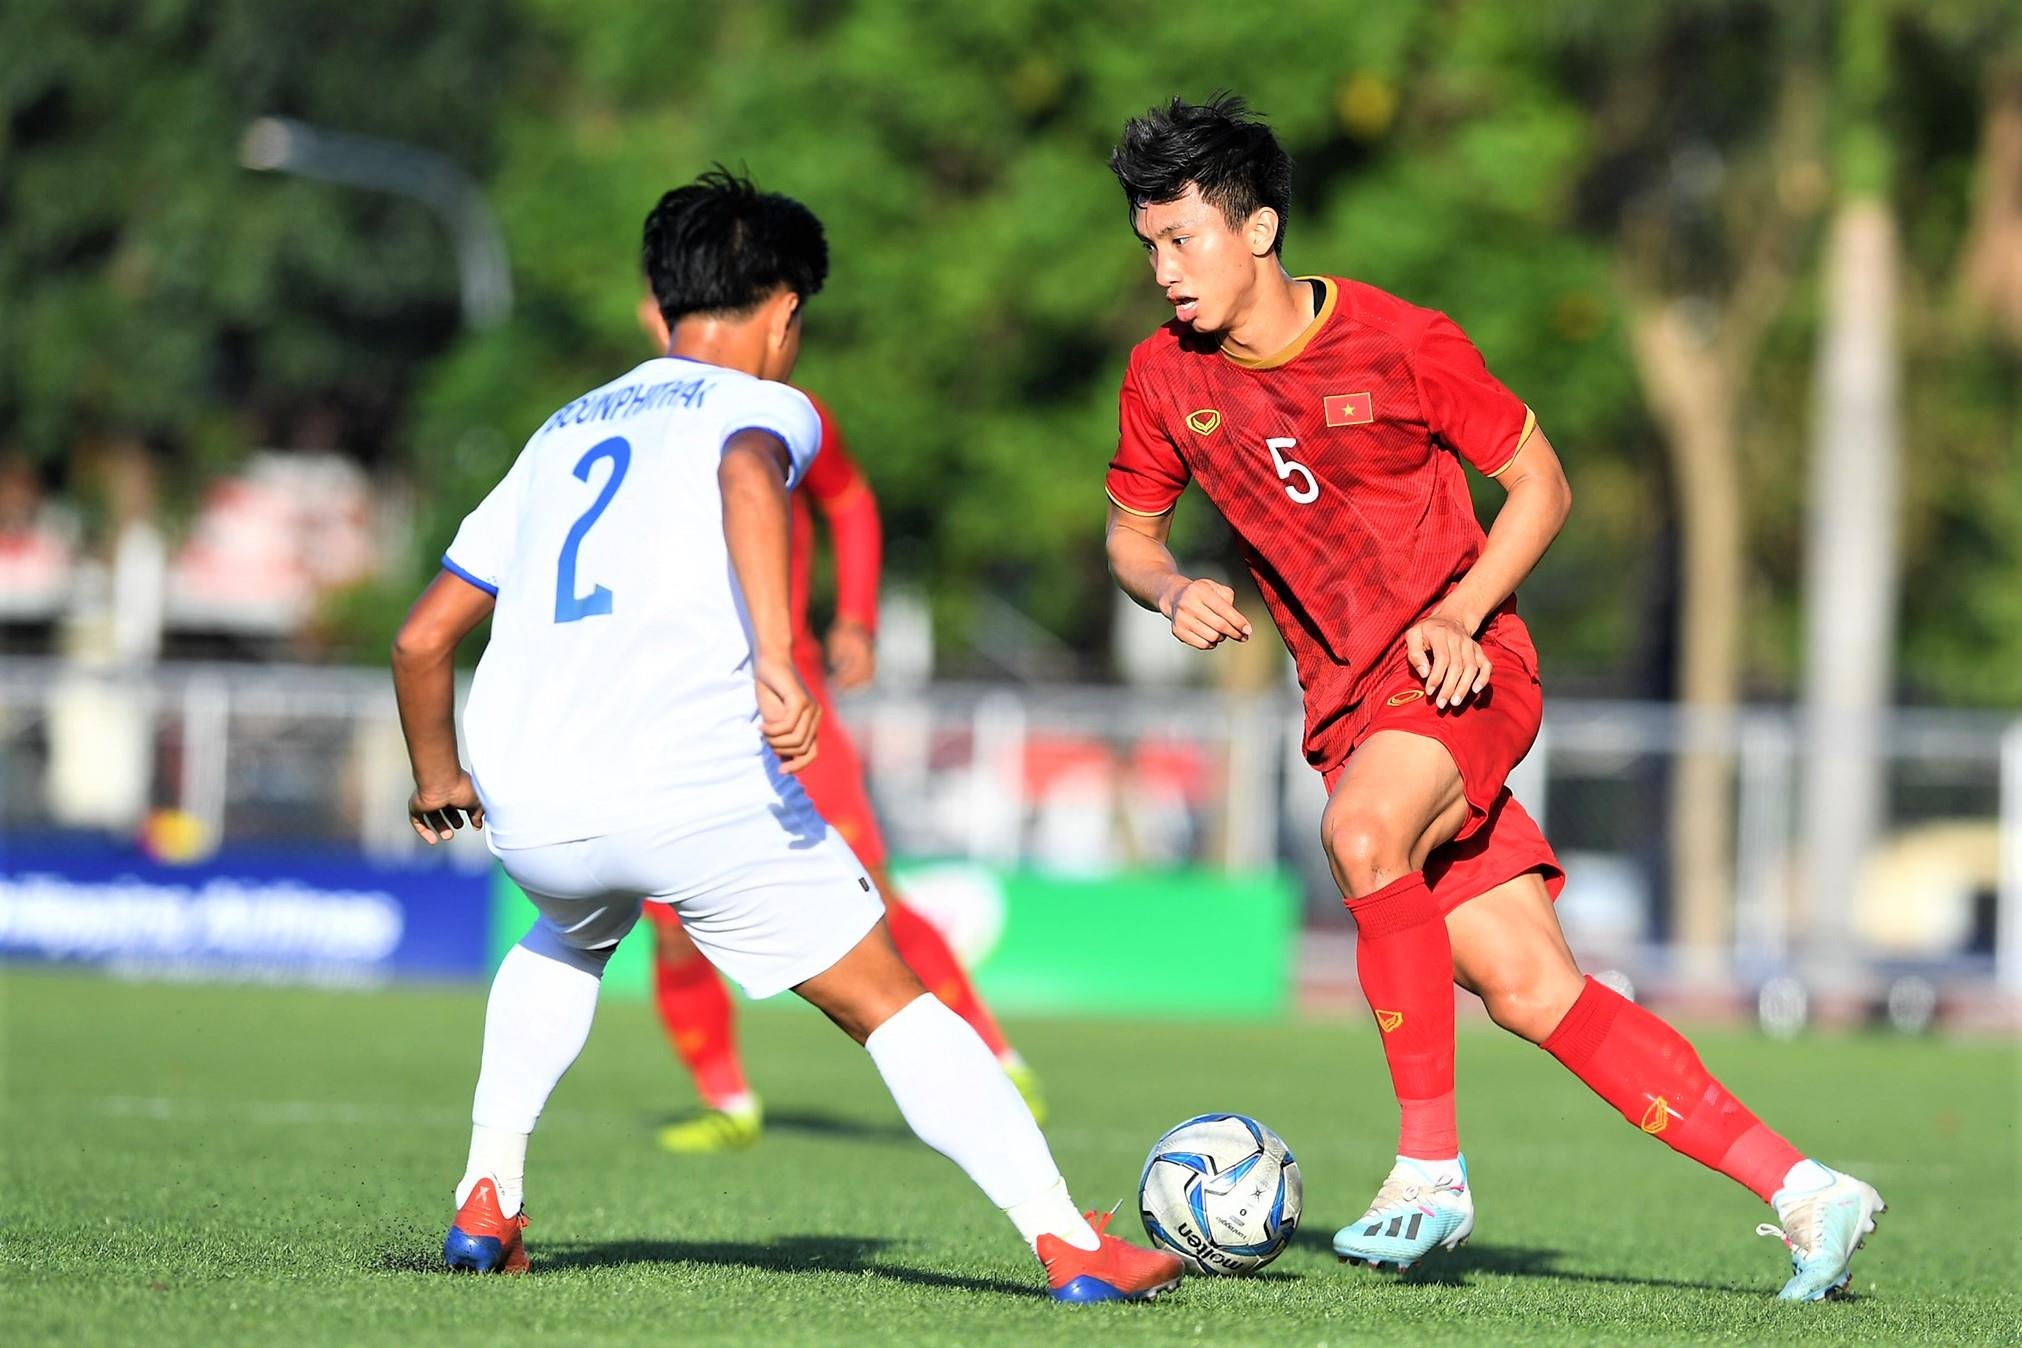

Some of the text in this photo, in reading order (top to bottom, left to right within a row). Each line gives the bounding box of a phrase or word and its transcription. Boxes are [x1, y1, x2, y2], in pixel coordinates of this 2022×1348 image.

[1265, 437, 1320, 504] 5
[554, 436, 631, 623] 2
[1178, 1222, 1244, 1270] molten
